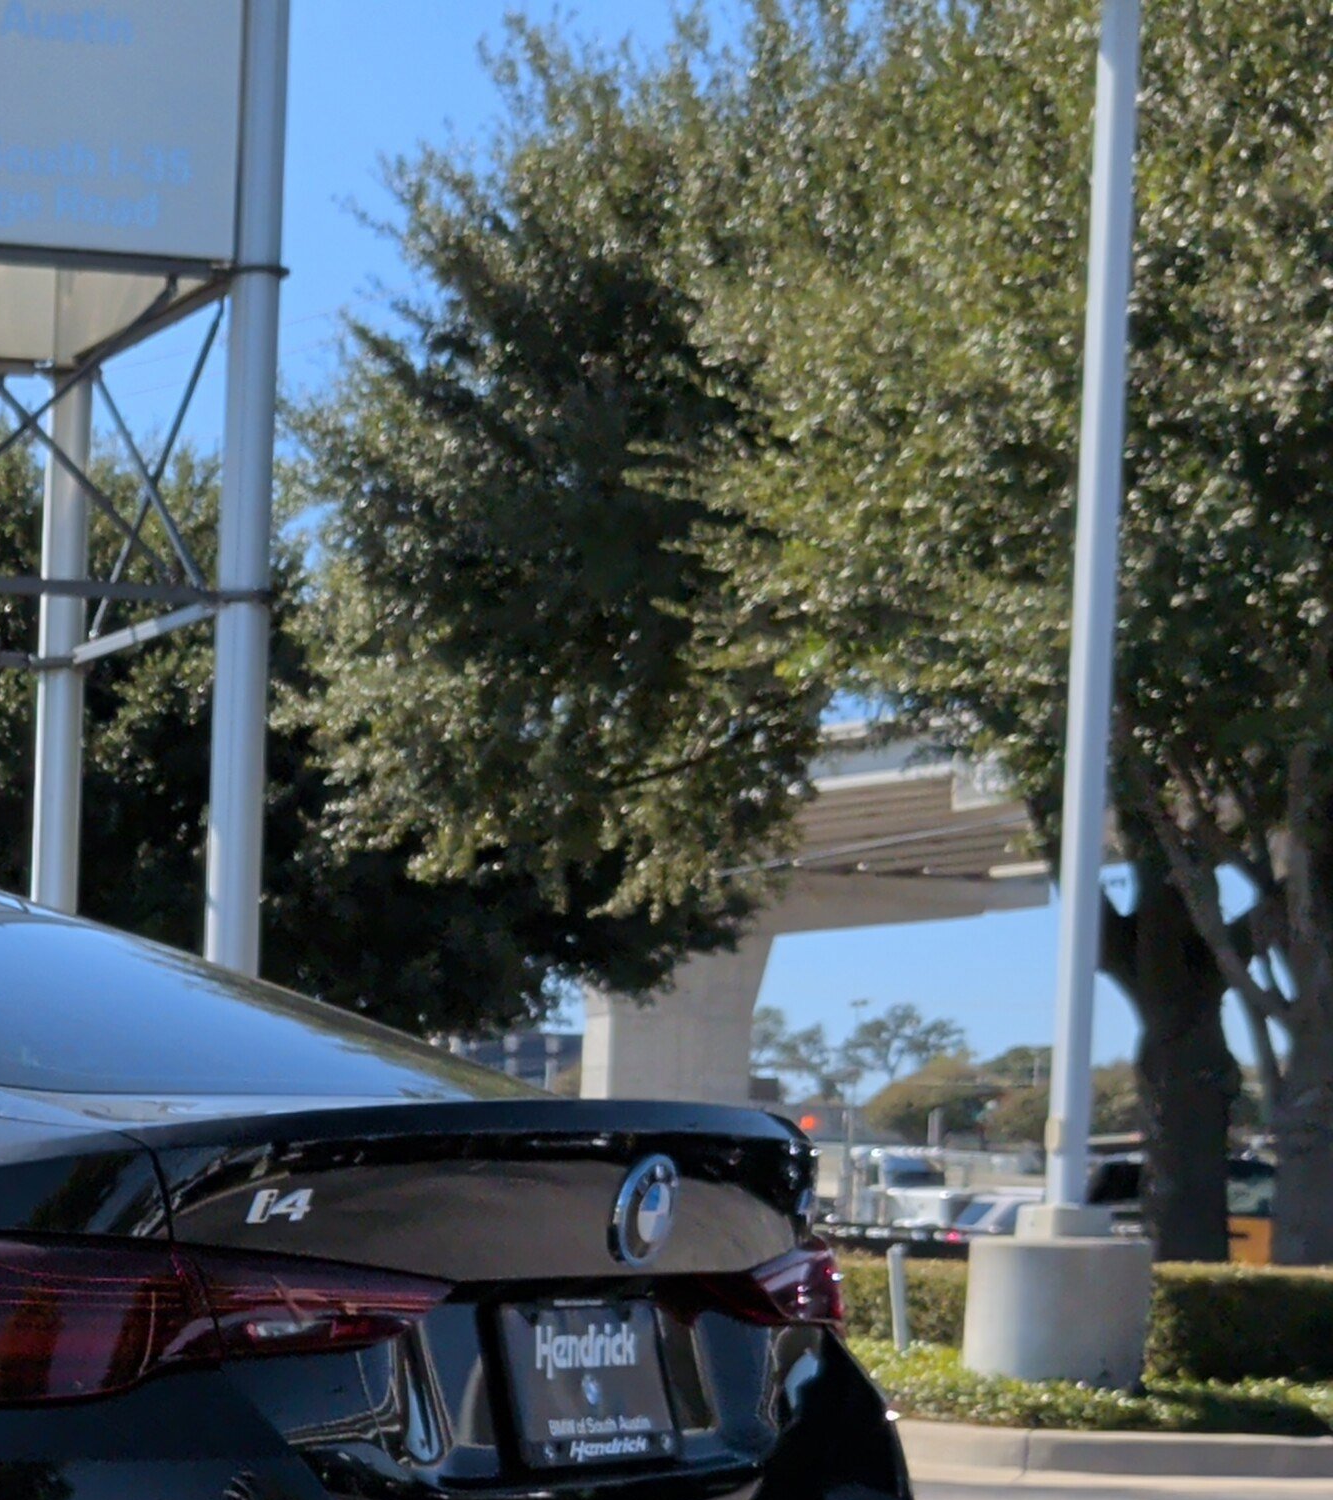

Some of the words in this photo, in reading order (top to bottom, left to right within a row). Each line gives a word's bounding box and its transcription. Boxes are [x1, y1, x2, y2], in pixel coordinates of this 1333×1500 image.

[1, 0, 134, 45] Austin
[54, 184, 161, 228] Road
[246, 1188, 314, 1224] i4
[535, 1322, 637, 1380] Hendrick
[548, 1418, 576, 1437] BMW
[586, 1415, 618, 1434] South
[618, 1415, 652, 1432] Austin
[569, 1435, 648, 1463] Hendrick
